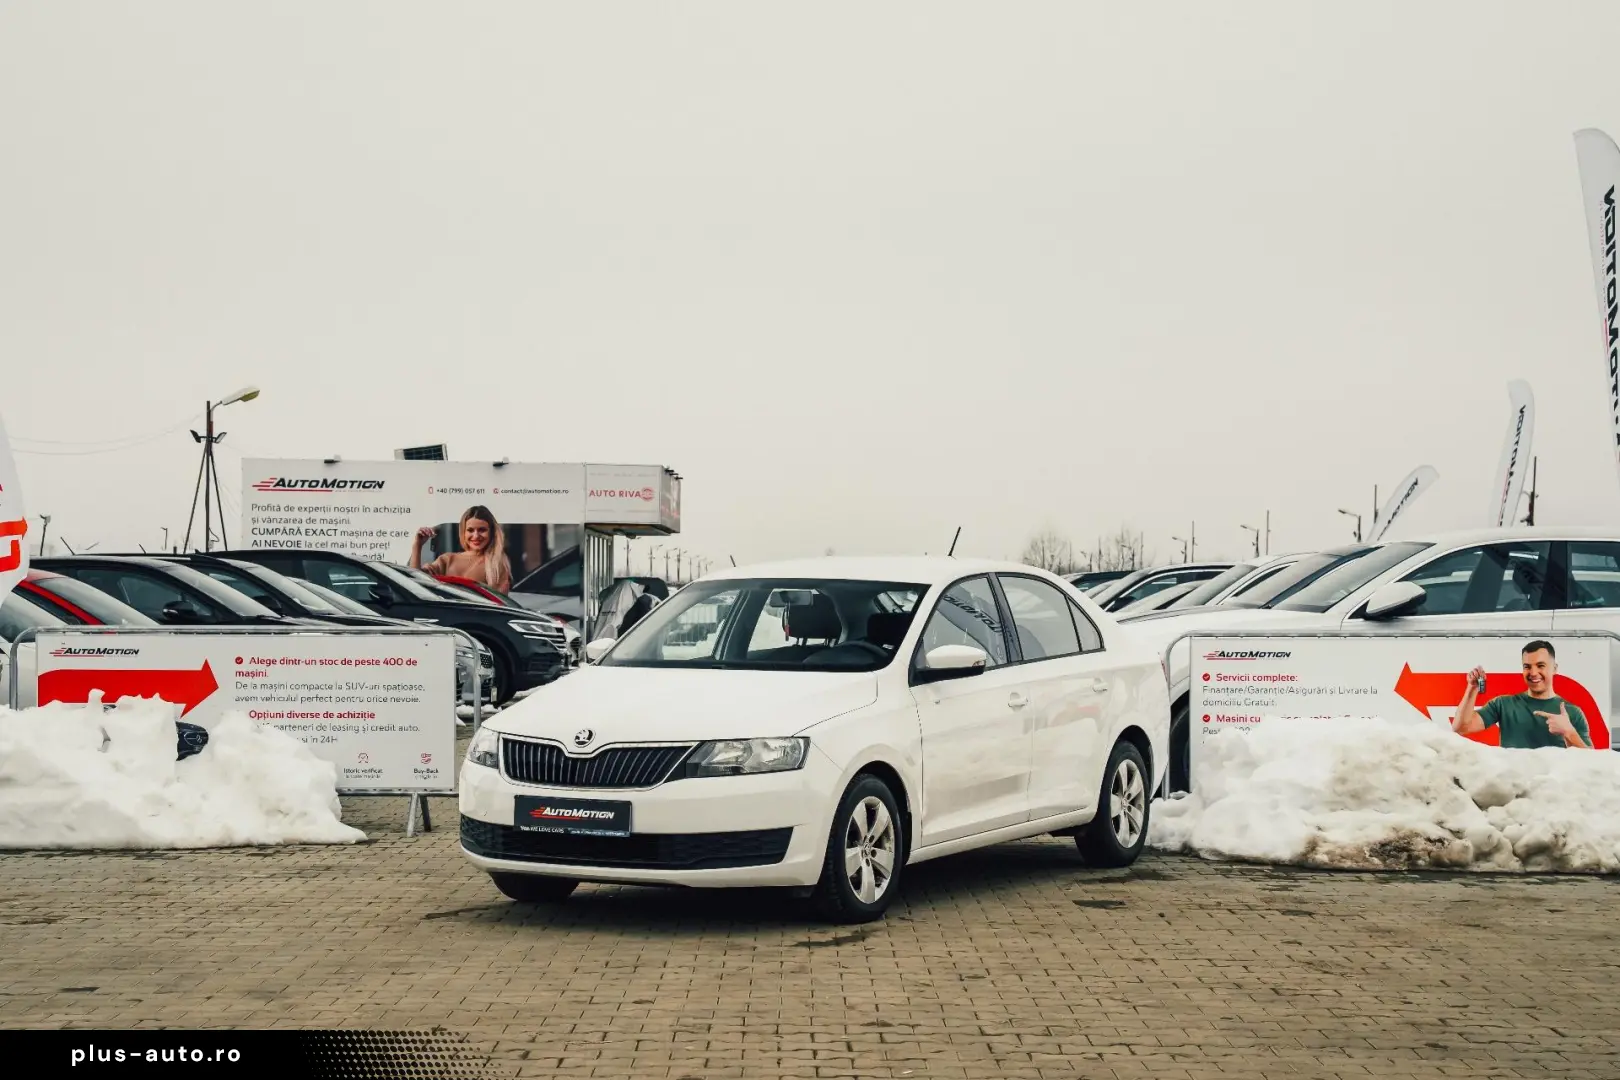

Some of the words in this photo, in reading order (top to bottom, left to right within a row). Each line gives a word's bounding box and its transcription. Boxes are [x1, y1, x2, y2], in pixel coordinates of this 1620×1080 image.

[589, 490, 616, 498] AUTO
[251, 503, 281, 512] Profită
[284, 504, 295, 512] de
[333, 504, 360, 515] noștri
[362, 505, 371, 513] în
[373, 505, 411, 515] achiziția
[262, 516, 303, 525] vânzarea
[305, 517, 317, 525] de
[251, 526, 303, 536] CUMPĂRĂ
[305, 528, 338, 537] EXACT
[340, 529, 374, 538] mașina
[375, 529, 388, 537] de
[251, 539, 262, 548] AI
[264, 539, 302, 548] NEVOIE
[304, 540, 312, 548] la
[314, 540, 328, 548] cel
[249, 656, 277, 667] Alege
[279, 657, 317, 666] dintr-un
[319, 658, 339, 666] stoc
[340, 658, 353, 666] de
[354, 659, 380, 668] peste
[383, 657, 404, 666] 400
[405, 658, 418, 666] de
[235, 669, 269, 679] mașini.
[1216, 673, 1250, 682] Servicii
[1252, 673, 1298, 683] complete:
[235, 681, 248, 690] De
[250, 681, 258, 690] la
[260, 681, 288, 692] mașini
[289, 682, 334, 692] compacte
[335, 682, 343, 690] la
[345, 682, 380, 691] SUV-uri
[1338, 686, 1368, 695] Livrare
[1370, 685, 1378, 695] la
[260, 693, 298, 702] vehiculul
[300, 694, 333, 704] perfect
[335, 695, 364, 704] pentru
[366, 695, 388, 703] orice
[249, 709, 284, 720] Opțiuni
[286, 710, 320, 719] diverse
[322, 710, 334, 719] de
[336, 710, 376, 721] achiziție
[315, 723, 327, 732] de
[329, 723, 360, 733] leasing
[370, 723, 396, 732] credit
[542, 807, 615, 820] AUTOMOTION
